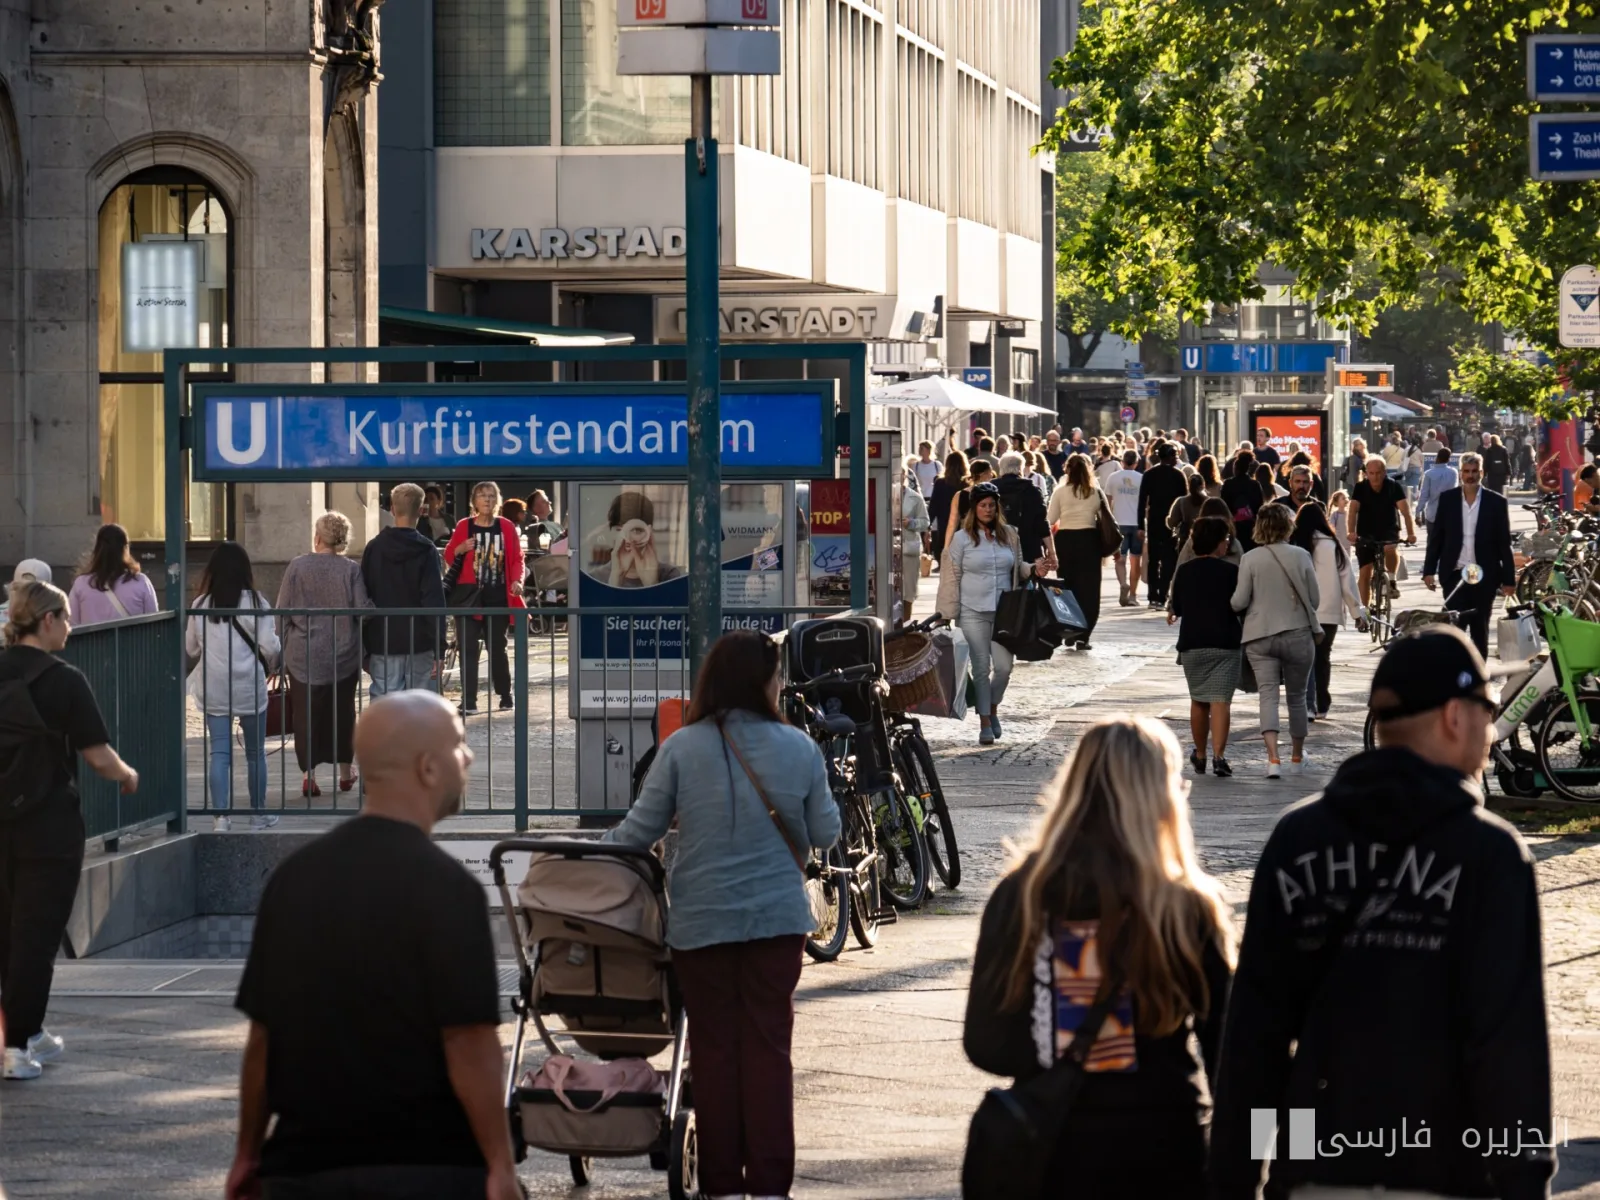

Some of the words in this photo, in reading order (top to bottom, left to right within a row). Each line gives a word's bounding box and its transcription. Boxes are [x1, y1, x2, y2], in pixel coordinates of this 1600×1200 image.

[471, 228, 687, 259] KARSTAD
[1186, 348, 1198, 368] U
[216, 402, 267, 464] U
[607, 616, 629, 630] Sie
